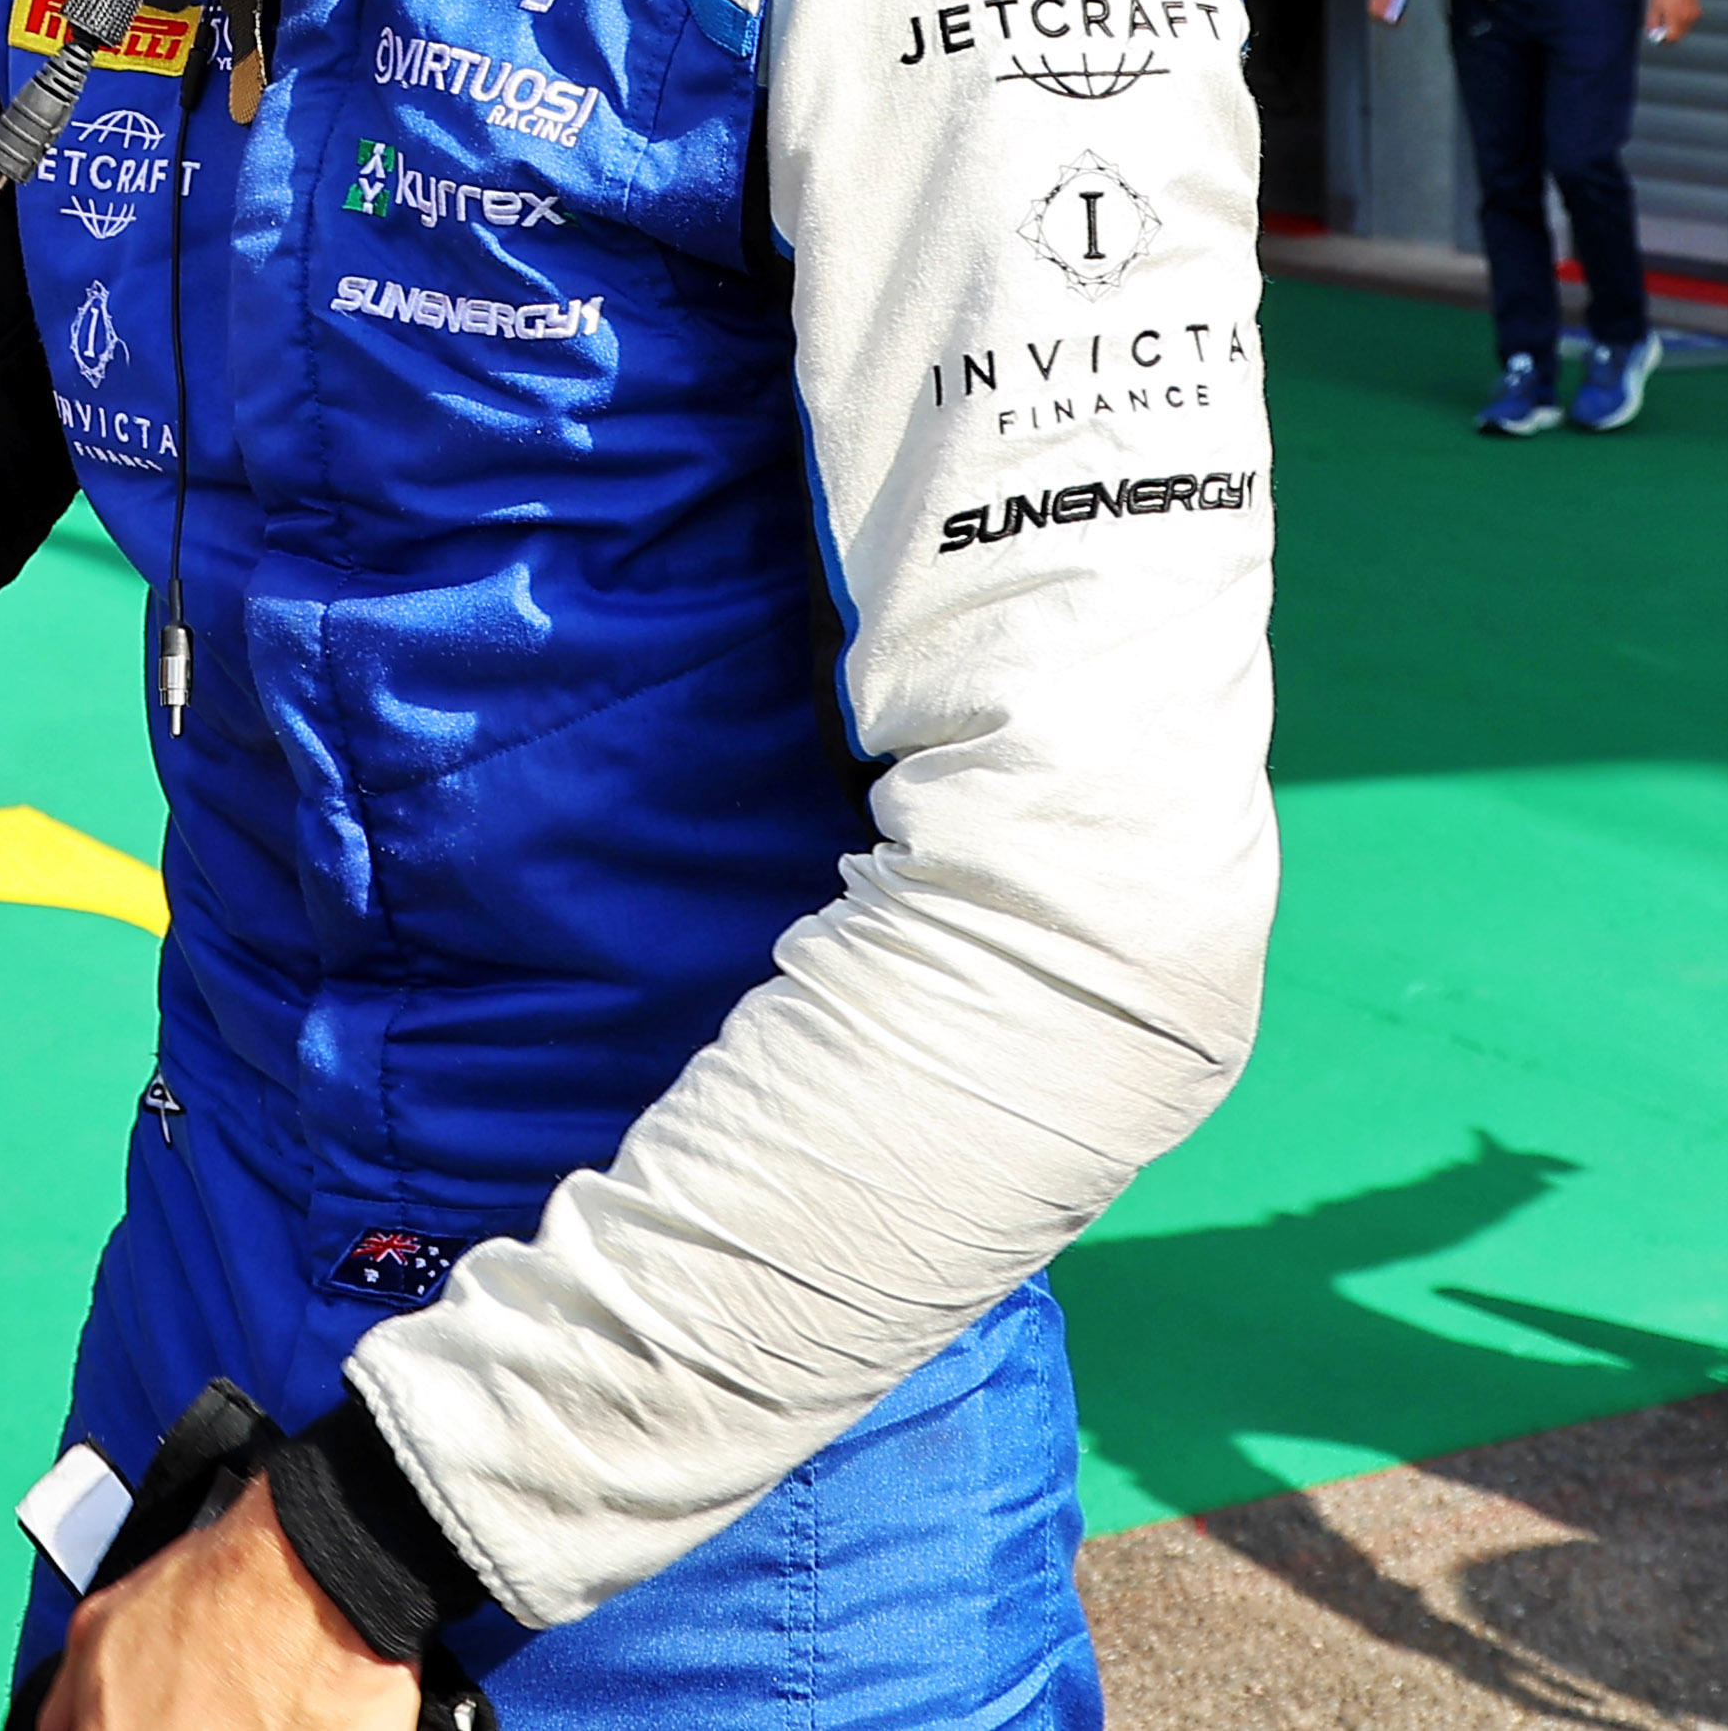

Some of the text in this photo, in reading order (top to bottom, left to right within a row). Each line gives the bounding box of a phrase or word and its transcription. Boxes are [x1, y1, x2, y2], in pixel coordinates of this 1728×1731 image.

[394, 31, 599, 128] VIRTUOSI
[486, 104, 580, 148] RACING
[37, 146, 202, 198] ETCRAFT
[395, 151, 567, 228] kyrrex
[932, 322, 1250, 408] INVICTA
[999, 383, 1211, 435] FINANCE
